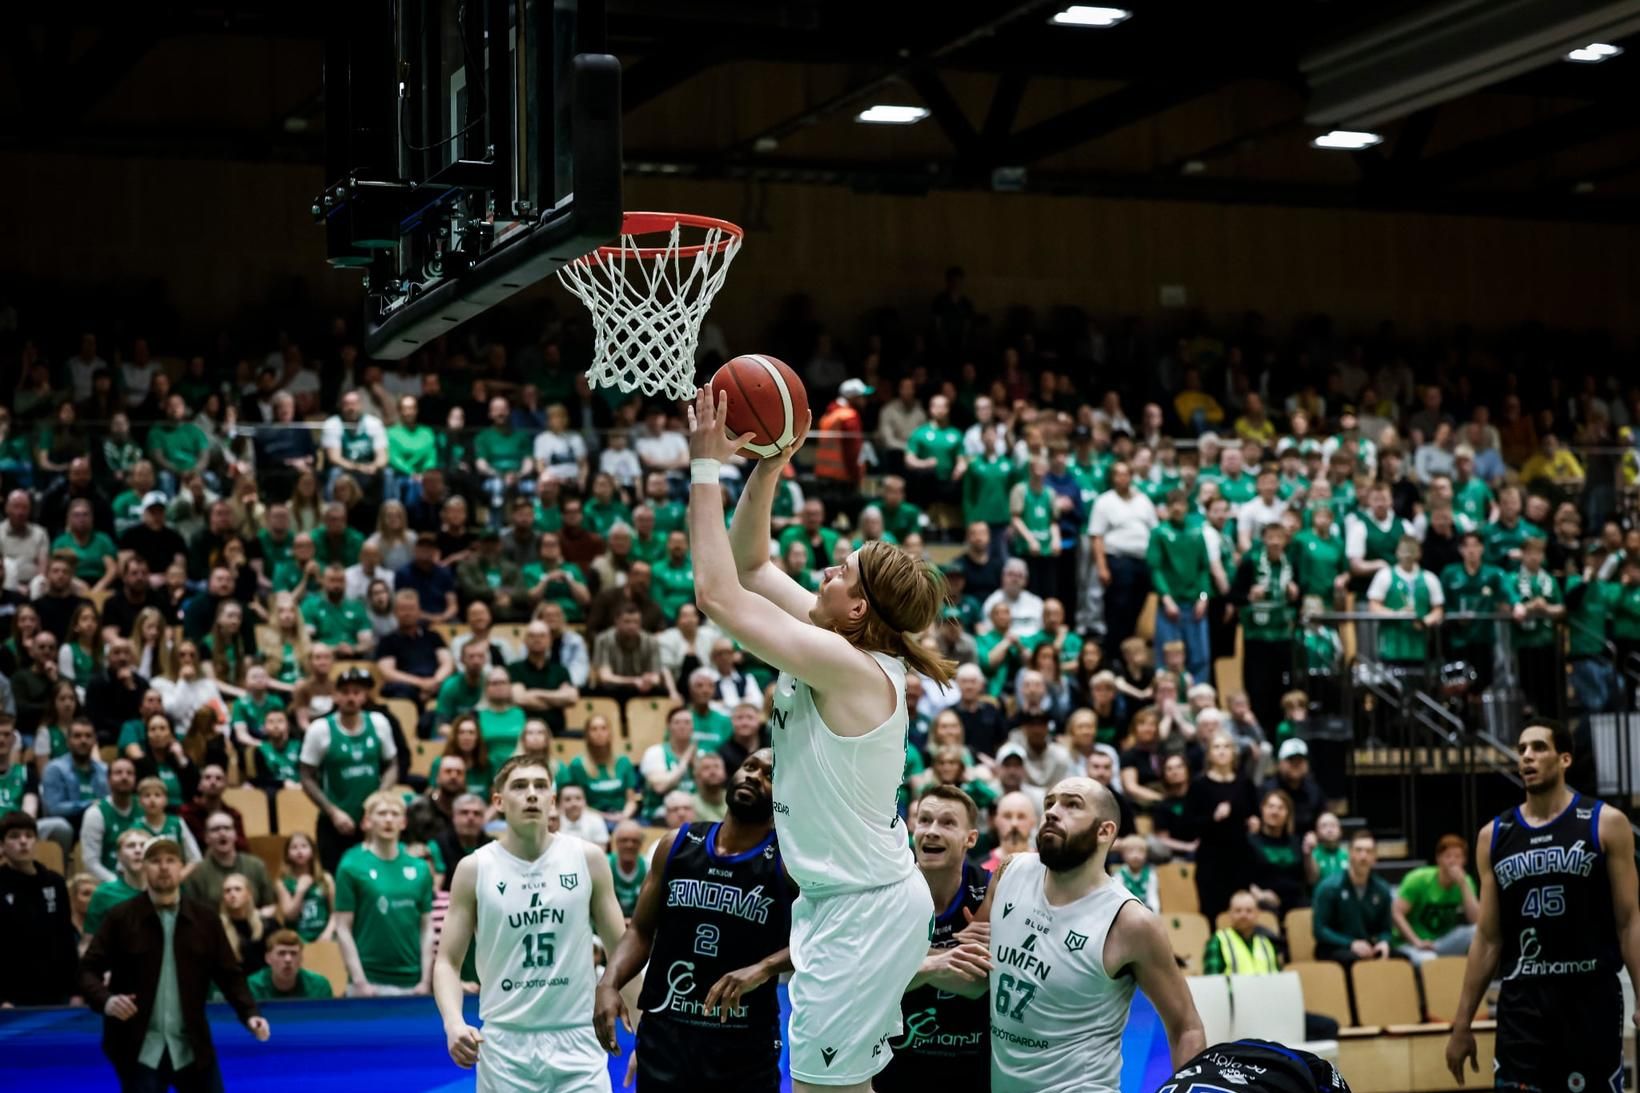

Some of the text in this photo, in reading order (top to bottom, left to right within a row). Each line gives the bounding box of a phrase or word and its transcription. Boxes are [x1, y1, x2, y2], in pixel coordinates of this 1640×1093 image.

[509, 909, 564, 928] UMFN
[1522, 886, 1566, 918] 45
[694, 923, 720, 957] 2
[1025, 918, 1050, 935] BLUE
[522, 932, 556, 969] 15
[997, 945, 1051, 981] UMFN
[1522, 959, 1598, 975] Einhamar
[995, 973, 1036, 1022] 67
